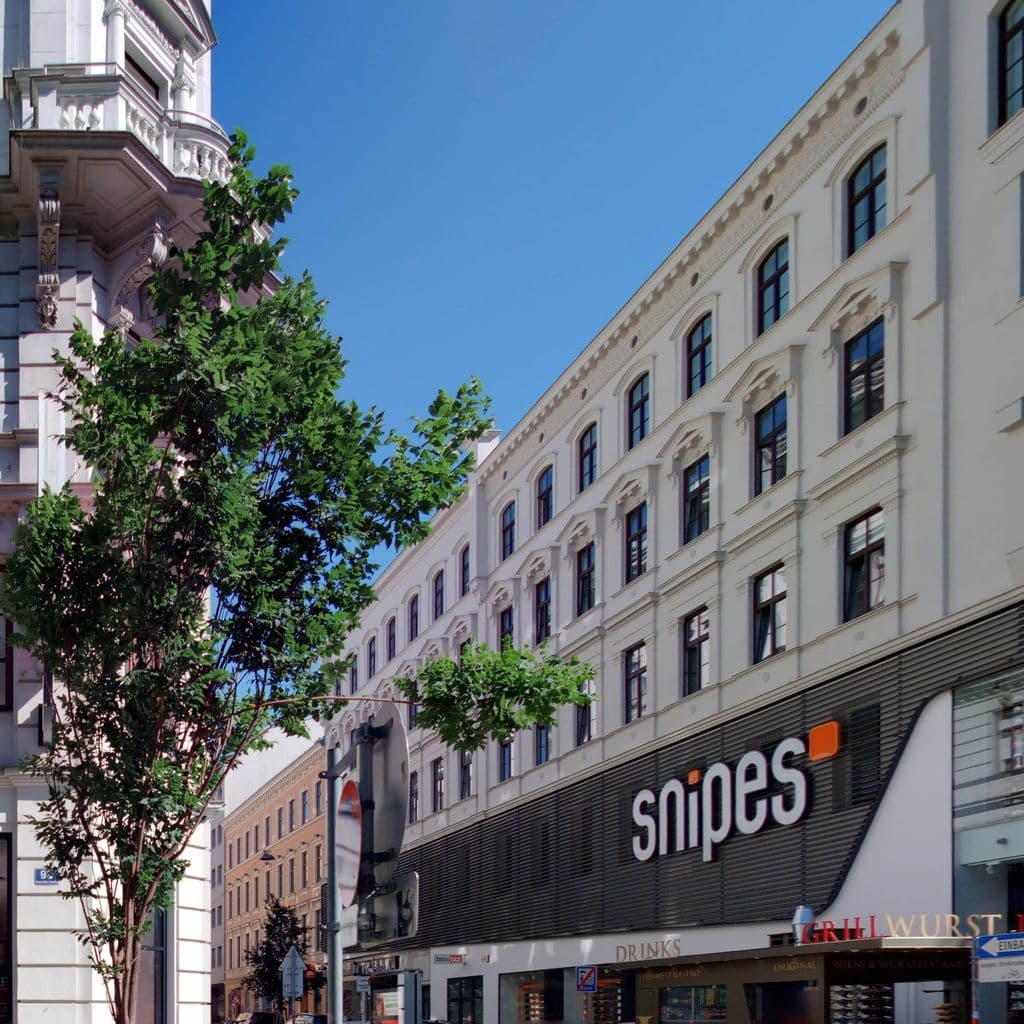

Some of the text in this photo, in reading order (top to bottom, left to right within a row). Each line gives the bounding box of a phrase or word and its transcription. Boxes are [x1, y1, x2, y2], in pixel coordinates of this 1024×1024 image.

[632, 737, 807, 862] snipes
[616, 938, 681, 963] DRINKS
[999, 938, 1024, 951] EINBA
[774, 959, 817, 971] ORIGINAL
